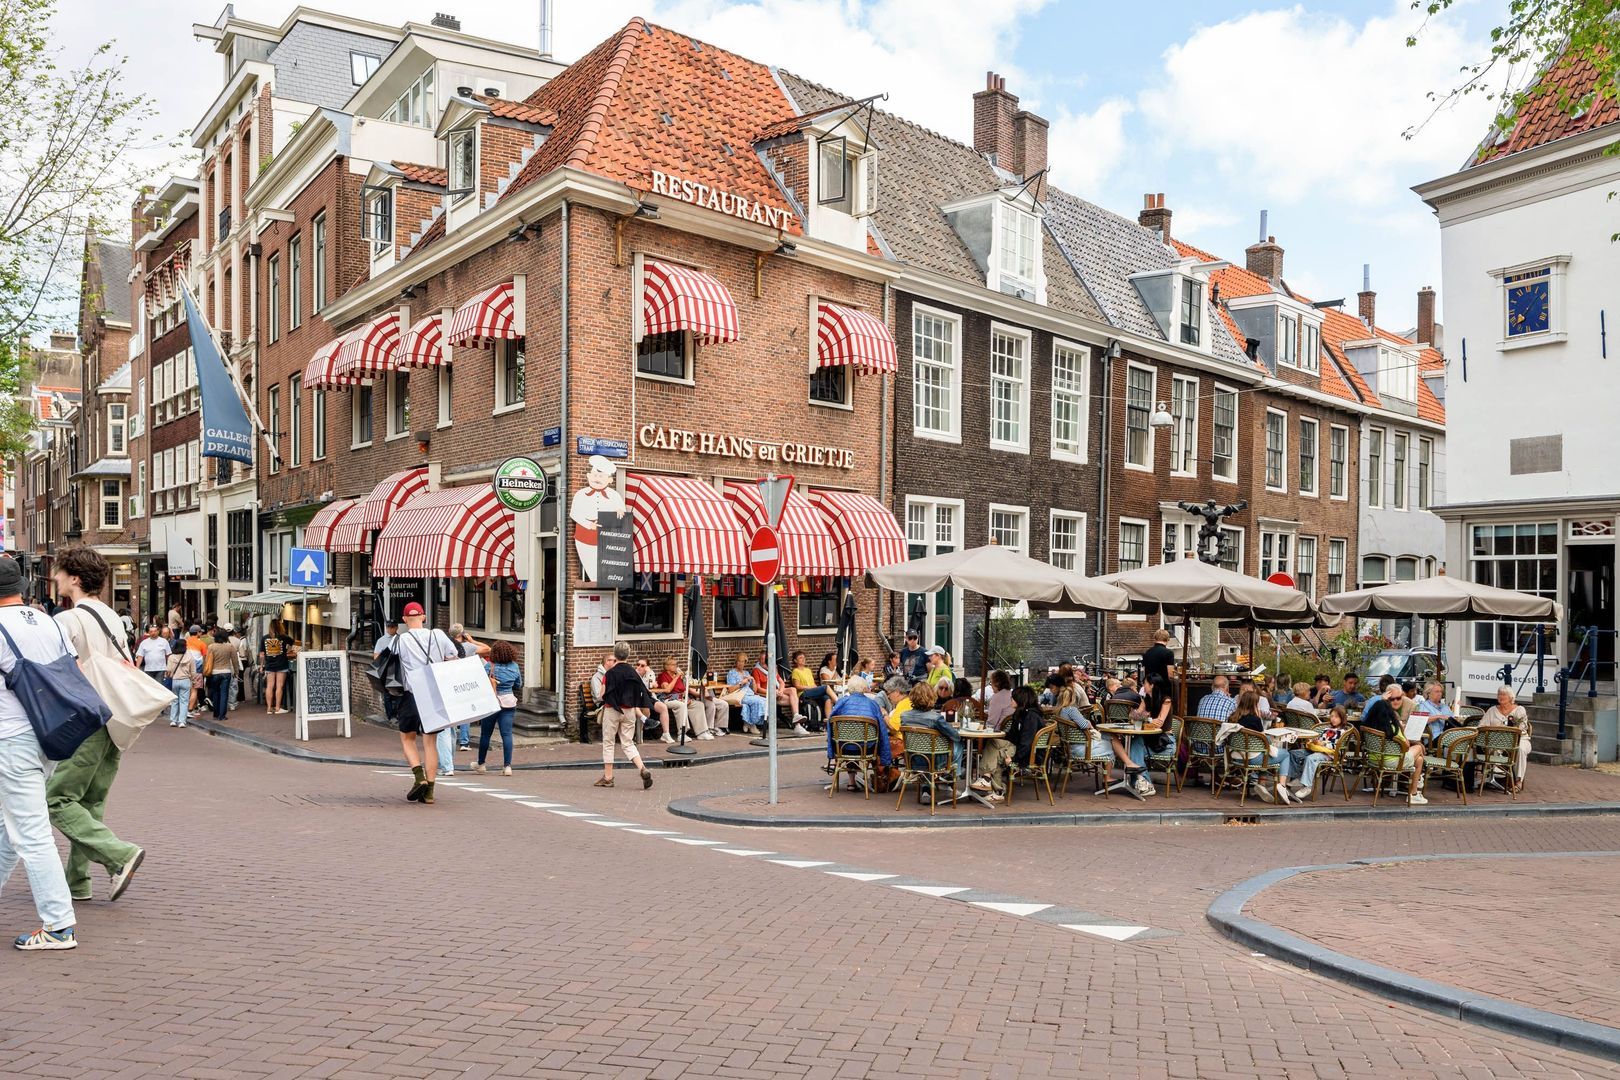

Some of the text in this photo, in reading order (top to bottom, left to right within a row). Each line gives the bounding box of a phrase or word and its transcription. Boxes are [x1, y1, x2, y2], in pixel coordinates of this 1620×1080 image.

[651, 170, 793, 232] RESTAURANT
[699, 432, 753, 459] HANS
[758, 443, 777, 461] en
[781, 442, 855, 469] GRIETJE
[501, 478, 542, 489] Heineken
[377, 581, 418, 589] Rtaurant
[453, 681, 479, 694] RIMOWA
